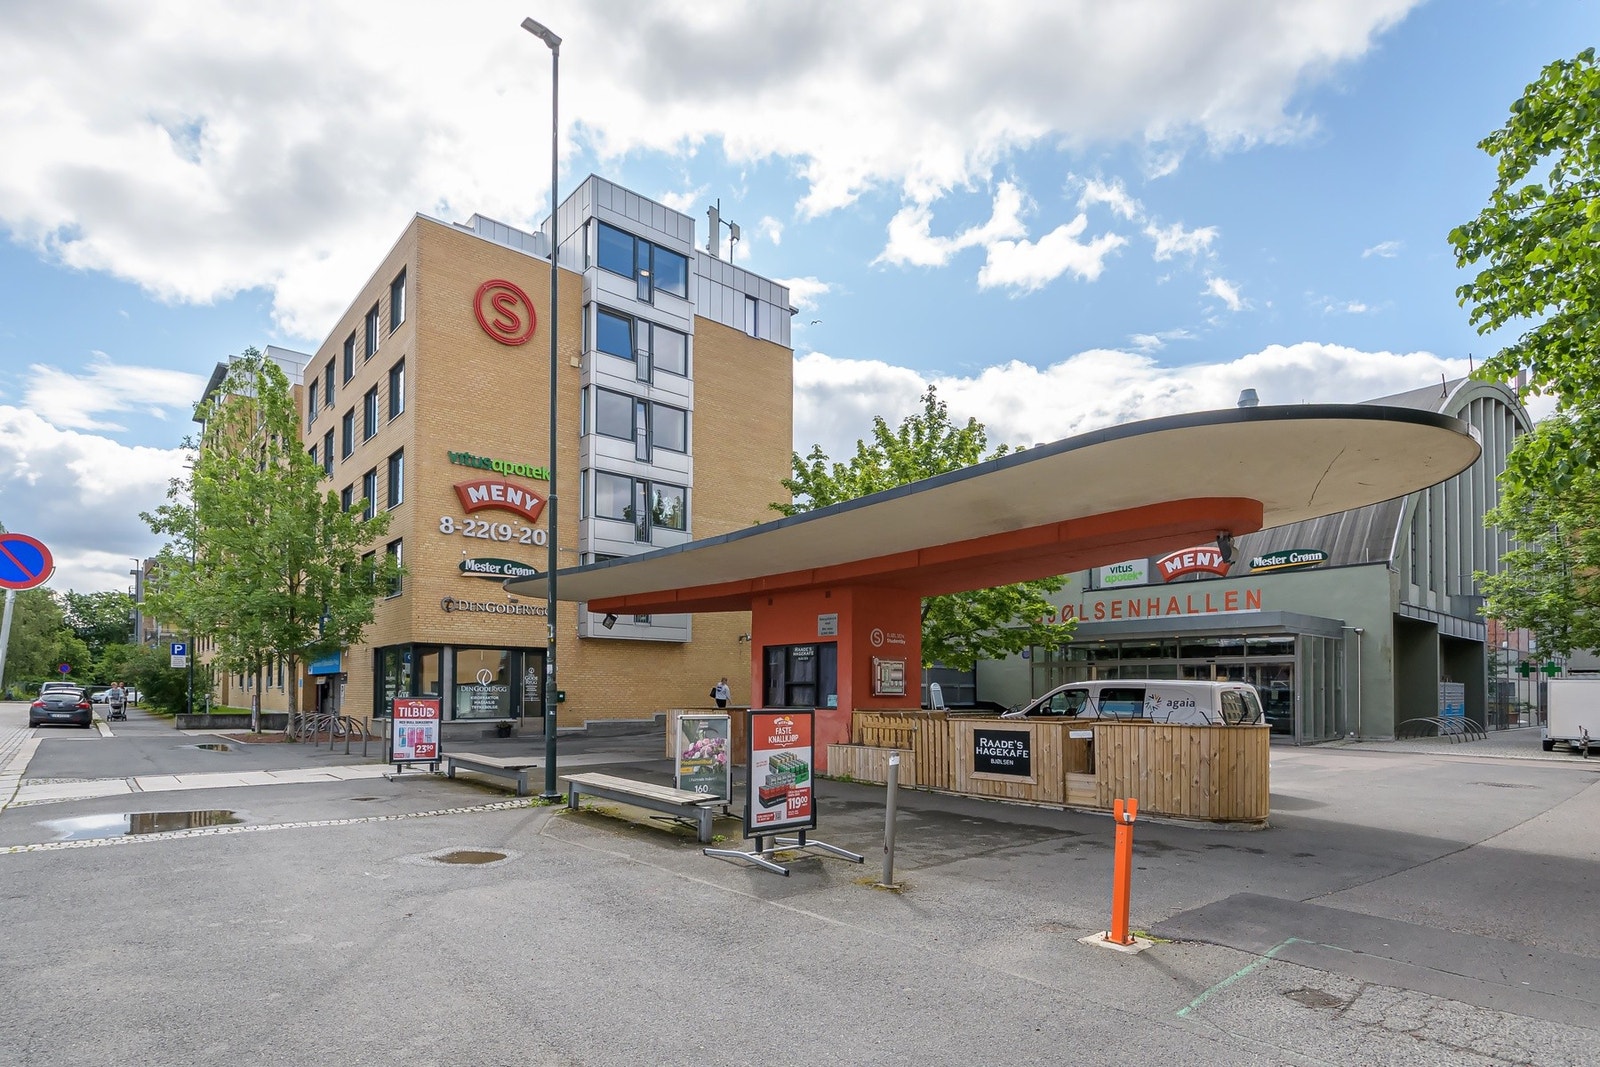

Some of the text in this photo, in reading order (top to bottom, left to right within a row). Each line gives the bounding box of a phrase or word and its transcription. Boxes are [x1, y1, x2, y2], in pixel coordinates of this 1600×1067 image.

[467, 484, 539, 511] MENY
[1165, 552, 1223, 574] MENY
[1253, 551, 1323, 567] Mester Grønn
[465, 559, 501, 573] Mester
[1109, 564, 1133, 574] vitus
[1105, 571, 1139, 584] apotek
[174, 644, 183, 654] P
[1166, 697, 1196, 710] agaia
[398, 706, 435, 717] TILBUD
[775, 727, 792, 735] FASTE
[768, 734, 799, 744] KNALLKJØP
[979, 738, 1024, 749] RAADE'S
[975, 746, 1029, 759] HAGEKAFE
[990, 758, 1014, 766] BJØLSEN
